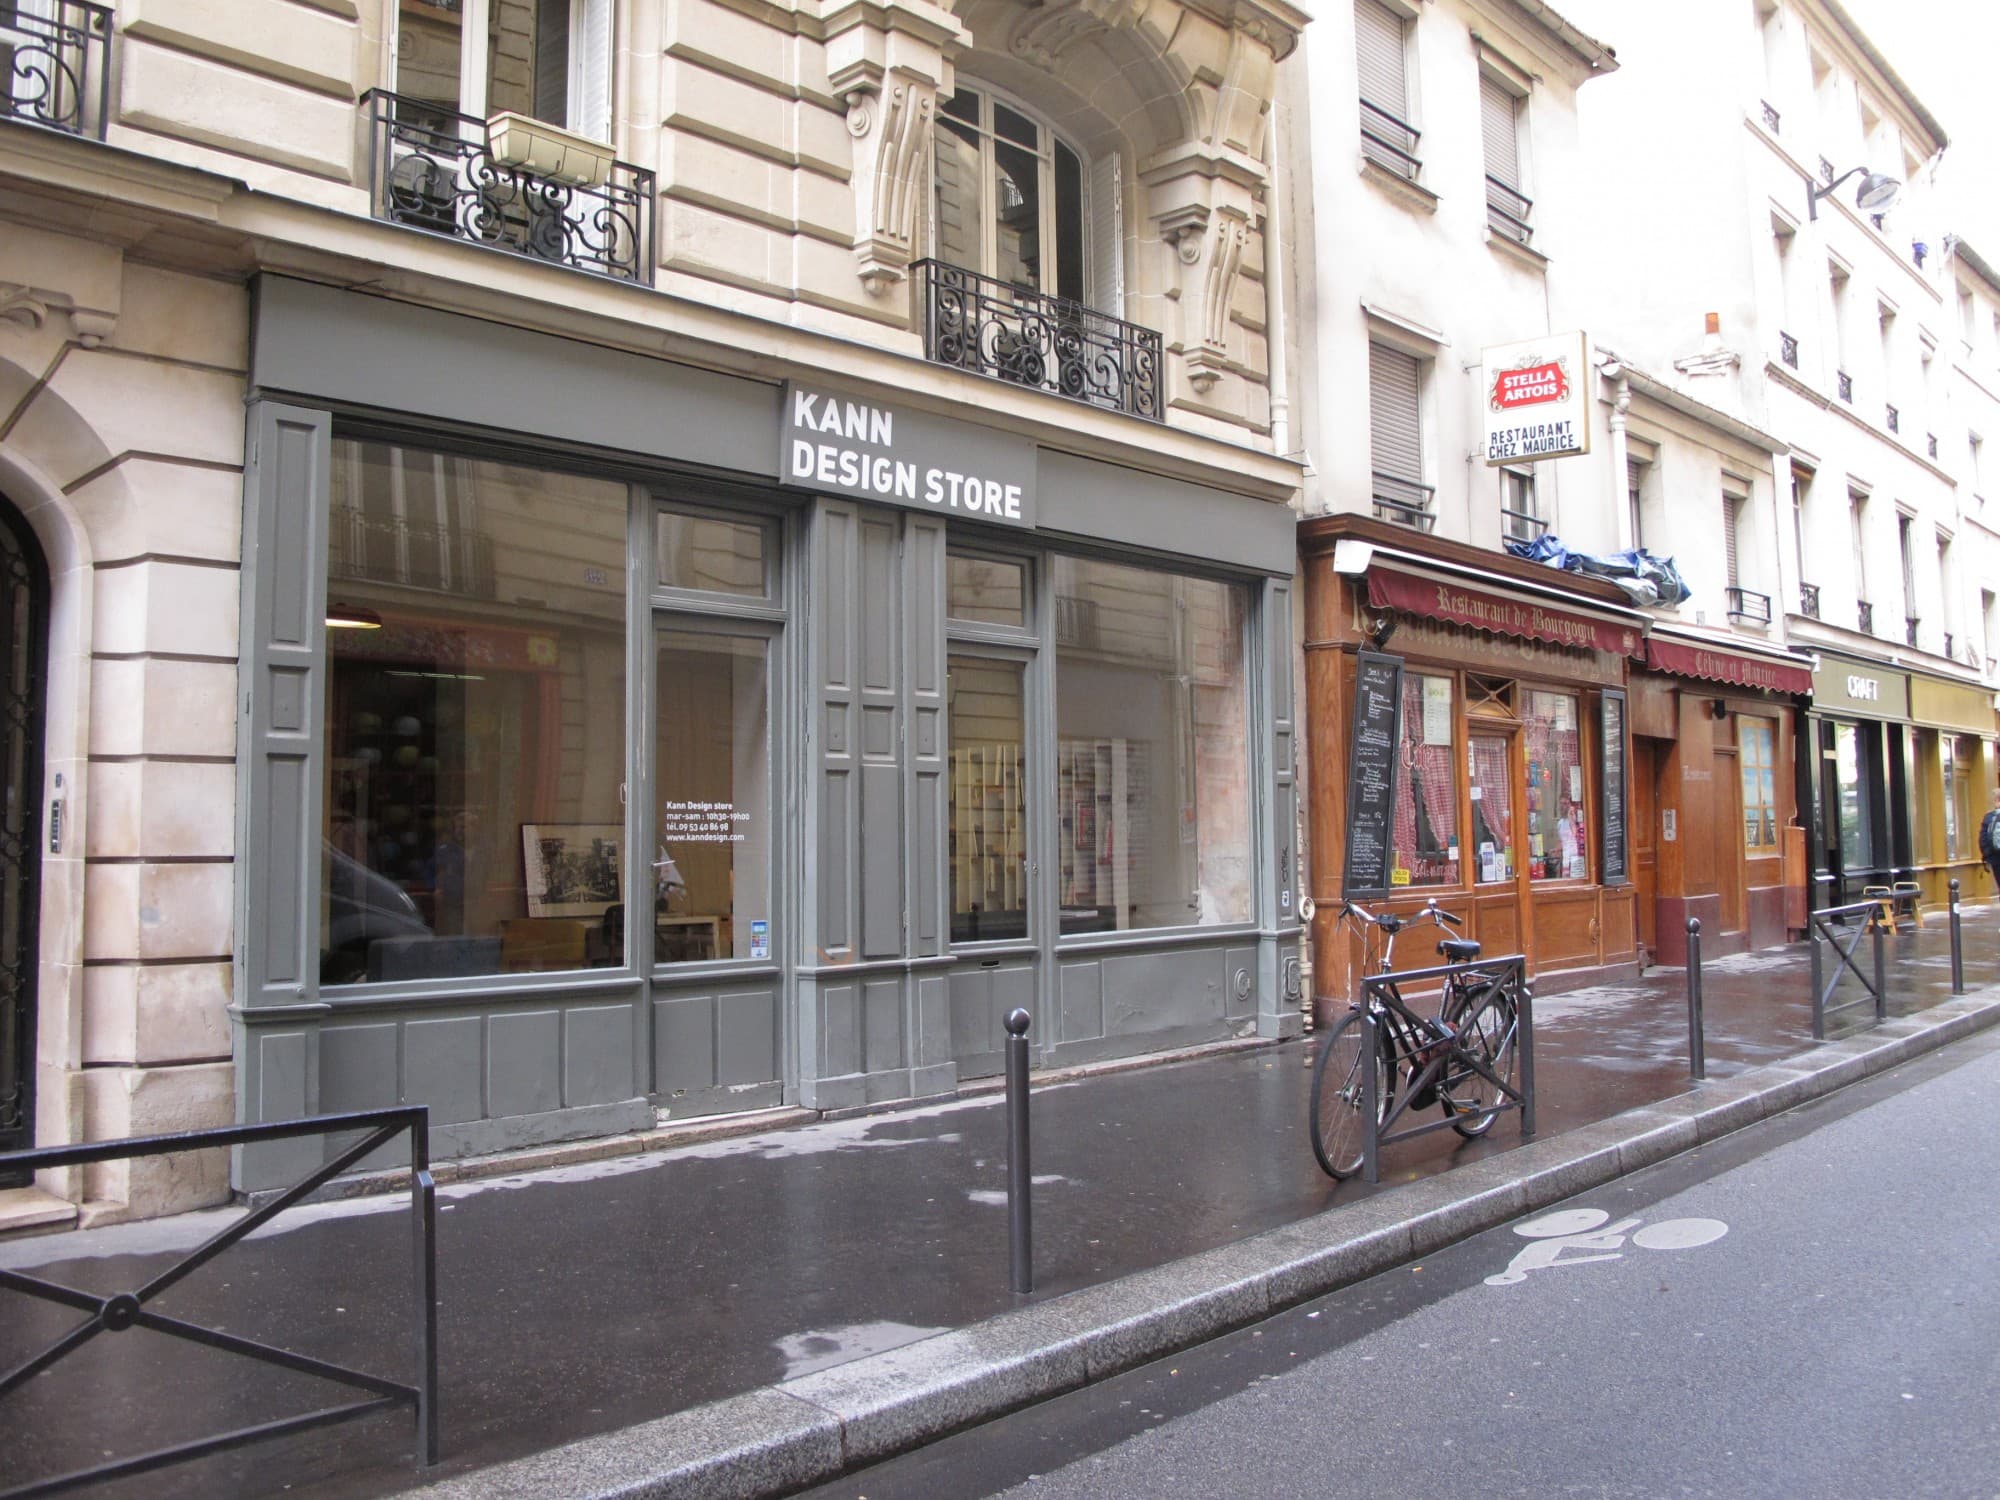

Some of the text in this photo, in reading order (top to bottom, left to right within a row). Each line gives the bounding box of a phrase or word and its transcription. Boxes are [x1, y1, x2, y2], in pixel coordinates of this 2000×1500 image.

[1503, 370, 1556, 389] STELLA
[1504, 383, 1558, 401] ARTOIS
[794, 390, 893, 447] KANN
[1491, 421, 1571, 445] RESTAURANT
[1489, 434, 1574, 459] CHEZ MAURICE
[792, 439, 1021, 519] DESIGN STORE
[1436, 586, 1510, 626] Restaurant
[1514, 606, 1527, 627] de
[1531, 607, 1595, 643] Bourgogne
[1847, 675, 1878, 700] CRAFT
[666, 801, 733, 811] Kann Design store
[706, 812, 750, 821] 10h30-19h00
[666, 833, 745, 842] www.kanndesign.com
[689, 823, 698, 831] 53
[699, 823, 708, 831] 40
[709, 822, 719, 831] 86
[719, 822, 729, 832] 98
